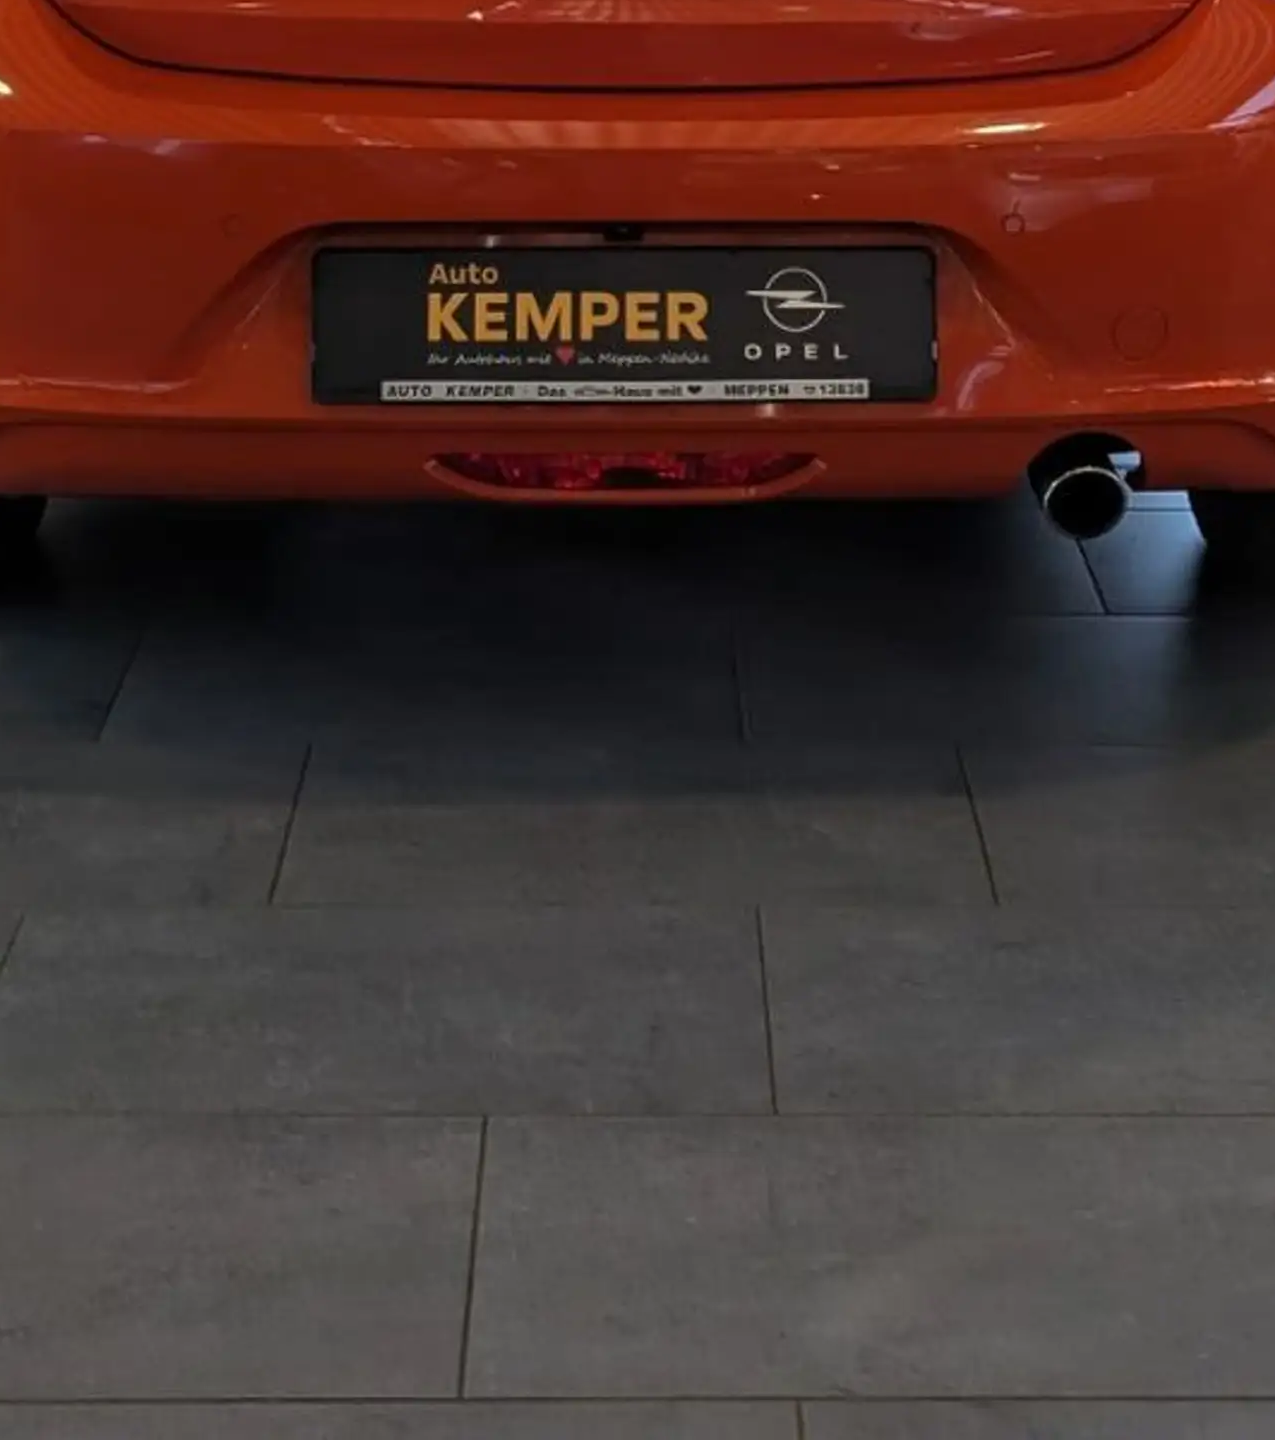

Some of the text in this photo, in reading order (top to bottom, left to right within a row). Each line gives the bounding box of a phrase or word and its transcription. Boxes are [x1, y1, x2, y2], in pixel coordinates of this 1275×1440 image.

[428, 263, 499, 285] Auto
[427, 291, 709, 342] KEMPER
[744, 343, 849, 361] OPEL
[386, 385, 433, 398] AUTO
[445, 385, 515, 398] KEMPER
[537, 385, 567, 397] Das
[657, 385, 683, 397] mit
[724, 383, 790, 396] MEPPEN
